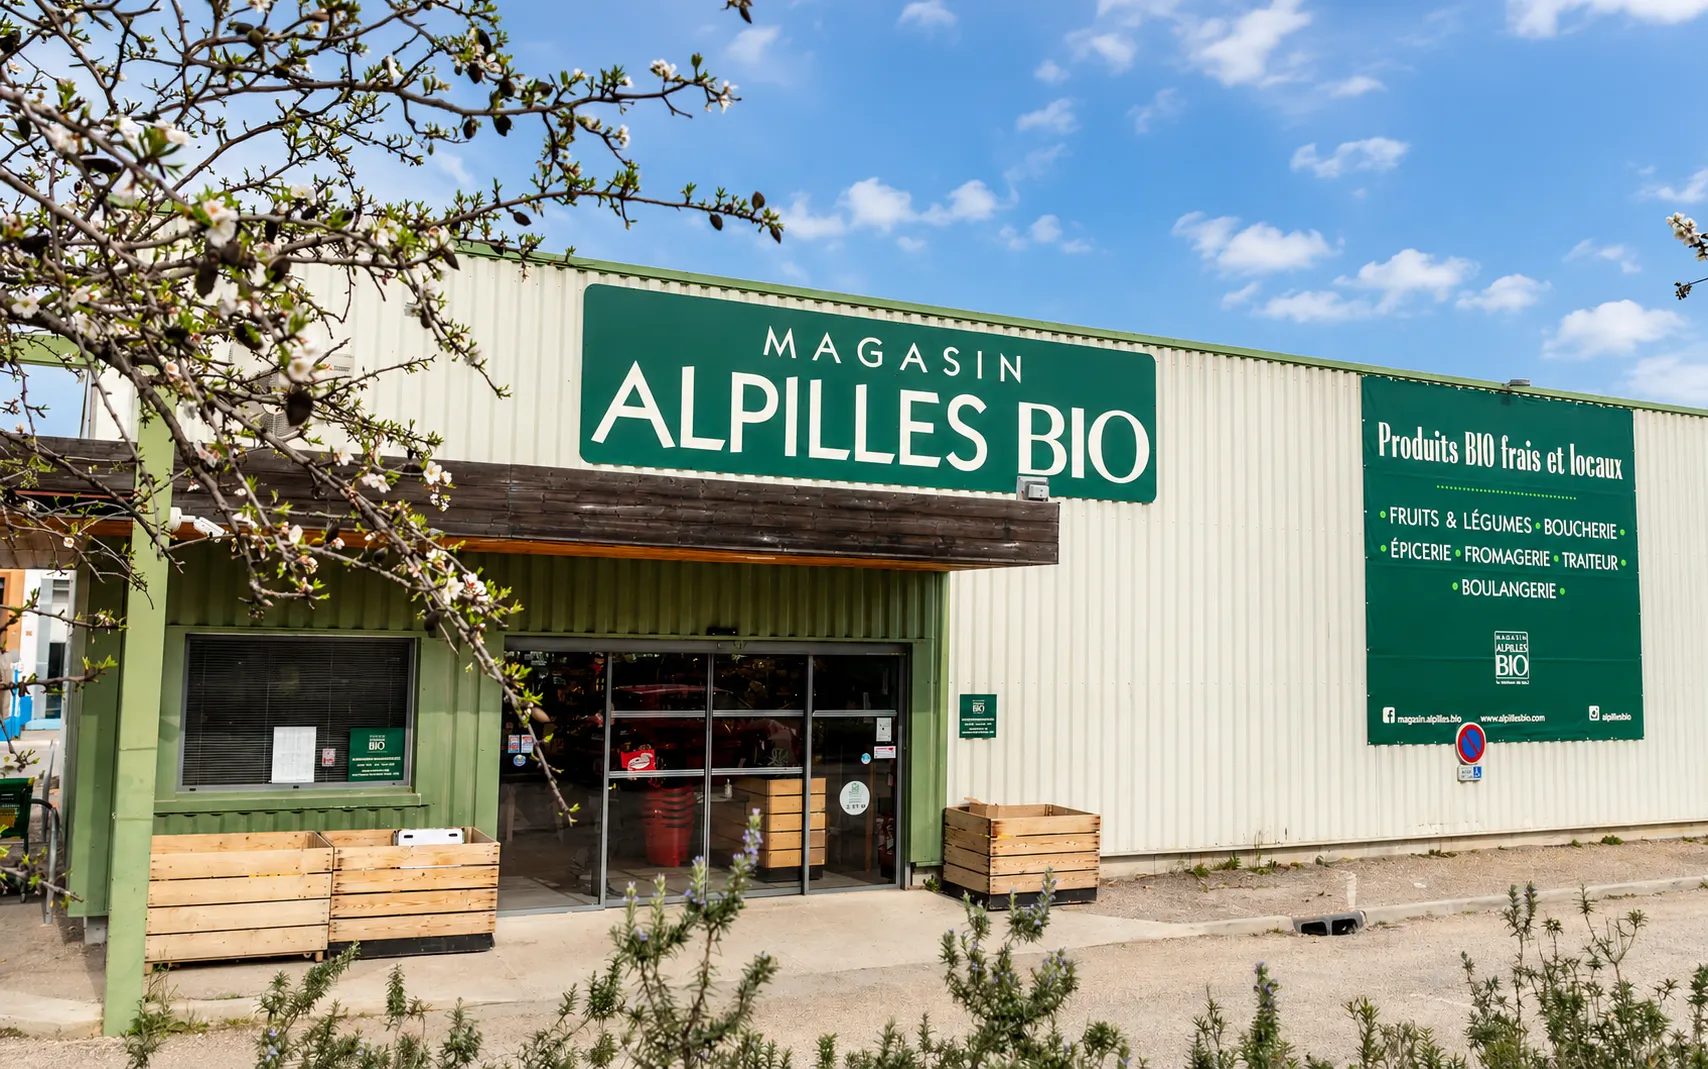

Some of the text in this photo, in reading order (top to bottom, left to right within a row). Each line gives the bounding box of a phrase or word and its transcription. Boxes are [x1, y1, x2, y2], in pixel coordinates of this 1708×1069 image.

[764, 325, 1022, 384] MAGASIN
[591, 361, 1150, 484] ALPILLES BIO
[1378, 421, 1624, 480] Produits BIO frais et locaux
[1389, 506, 1618, 540] FRUITS & LÉGUMES BOUCHERIE
[1390, 537, 1619, 571] ÉPICERIE FROMAGERIE TRAITEUR
[1461, 578, 1557, 599] BOULANGERIE
[1496, 654, 1529, 677] BIO
[1480, 713, 1546, 724] www.alpillesbio.com
[368, 742, 385, 751] BIO
